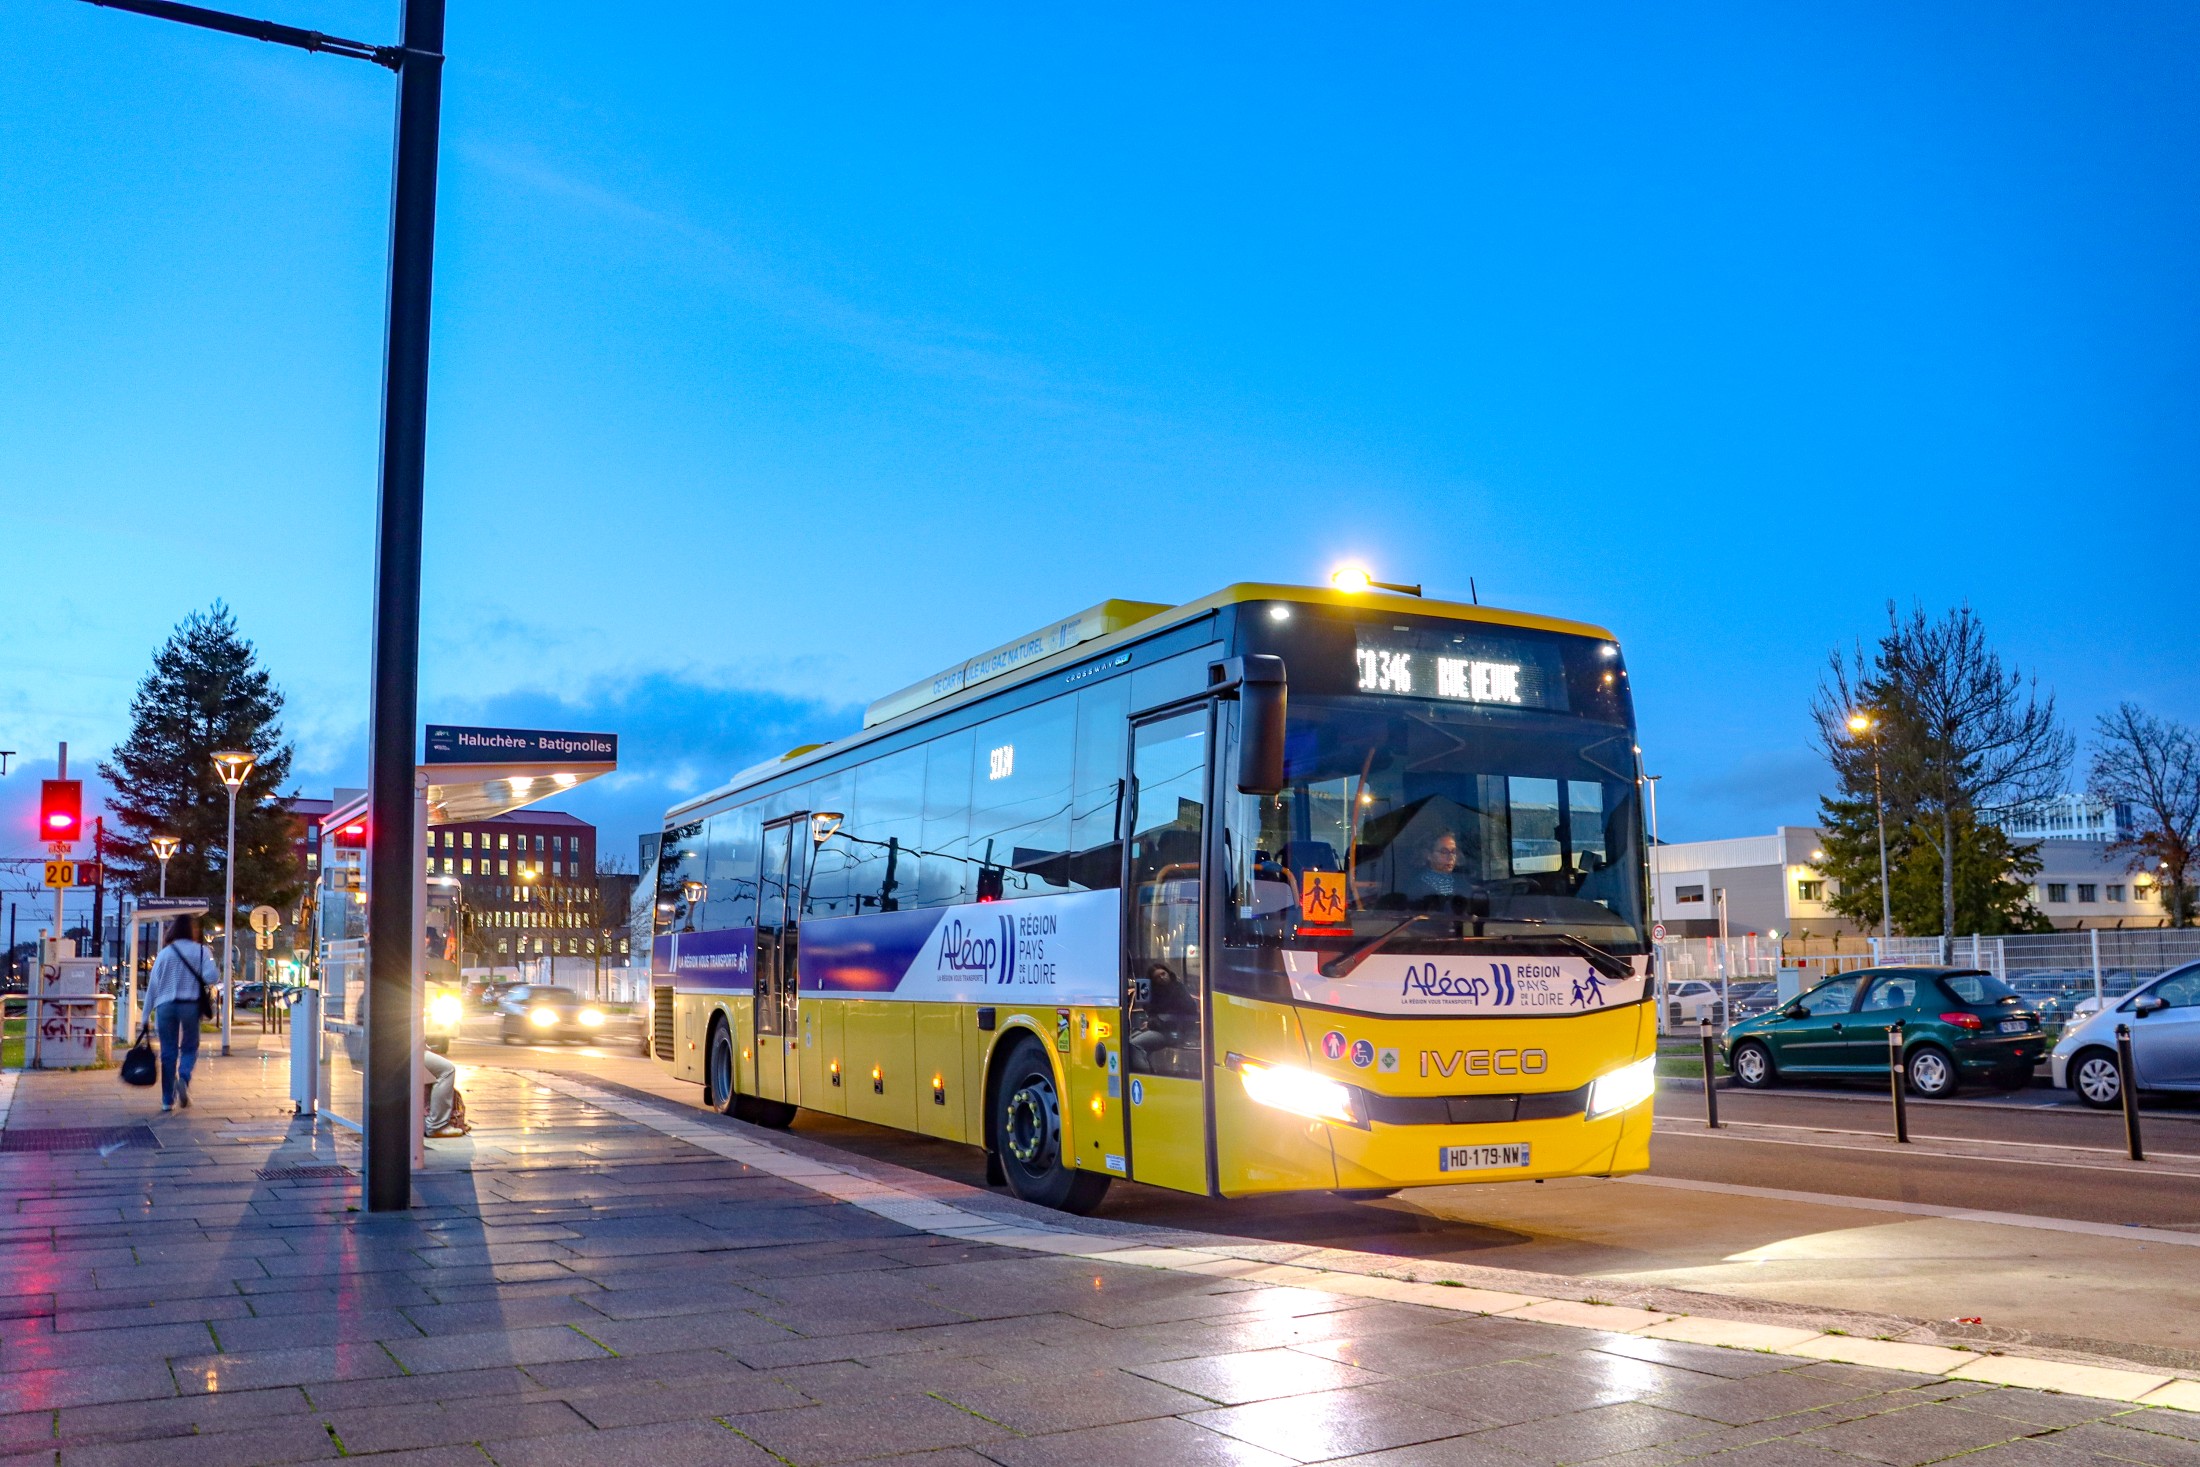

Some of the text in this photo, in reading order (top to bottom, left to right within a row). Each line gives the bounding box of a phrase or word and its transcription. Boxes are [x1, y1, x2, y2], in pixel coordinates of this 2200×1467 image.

[942, 673, 957, 691] CAR
[981, 660, 991, 675] AU
[991, 651, 1008, 671] GAZ
[1008, 638, 1044, 665] NATUREL
[1065, 660, 1114, 683] CROSSWAY
[458, 732, 527, 749] Haluchère
[538, 737, 612, 753] Batignolles
[46, 865, 72, 883] 20
[1020, 912, 1056, 936] RÉGION
[937, 918, 996, 984] Aléop
[1019, 939, 1044, 960] PAYS
[684, 953, 699, 968] RÉGION
[699, 954, 710, 968] VOUS
[710, 953, 738, 968] TRANSPORTE
[1517, 963, 1560, 978] RÉGION
[1028, 963, 1056, 984] LOIRE
[1402, 962, 1490, 1006] Aléop
[1517, 979, 1549, 991] PAYS
[1531, 992, 1564, 1006] LOIRE
[1420, 1049, 1548, 1077] IVECO
